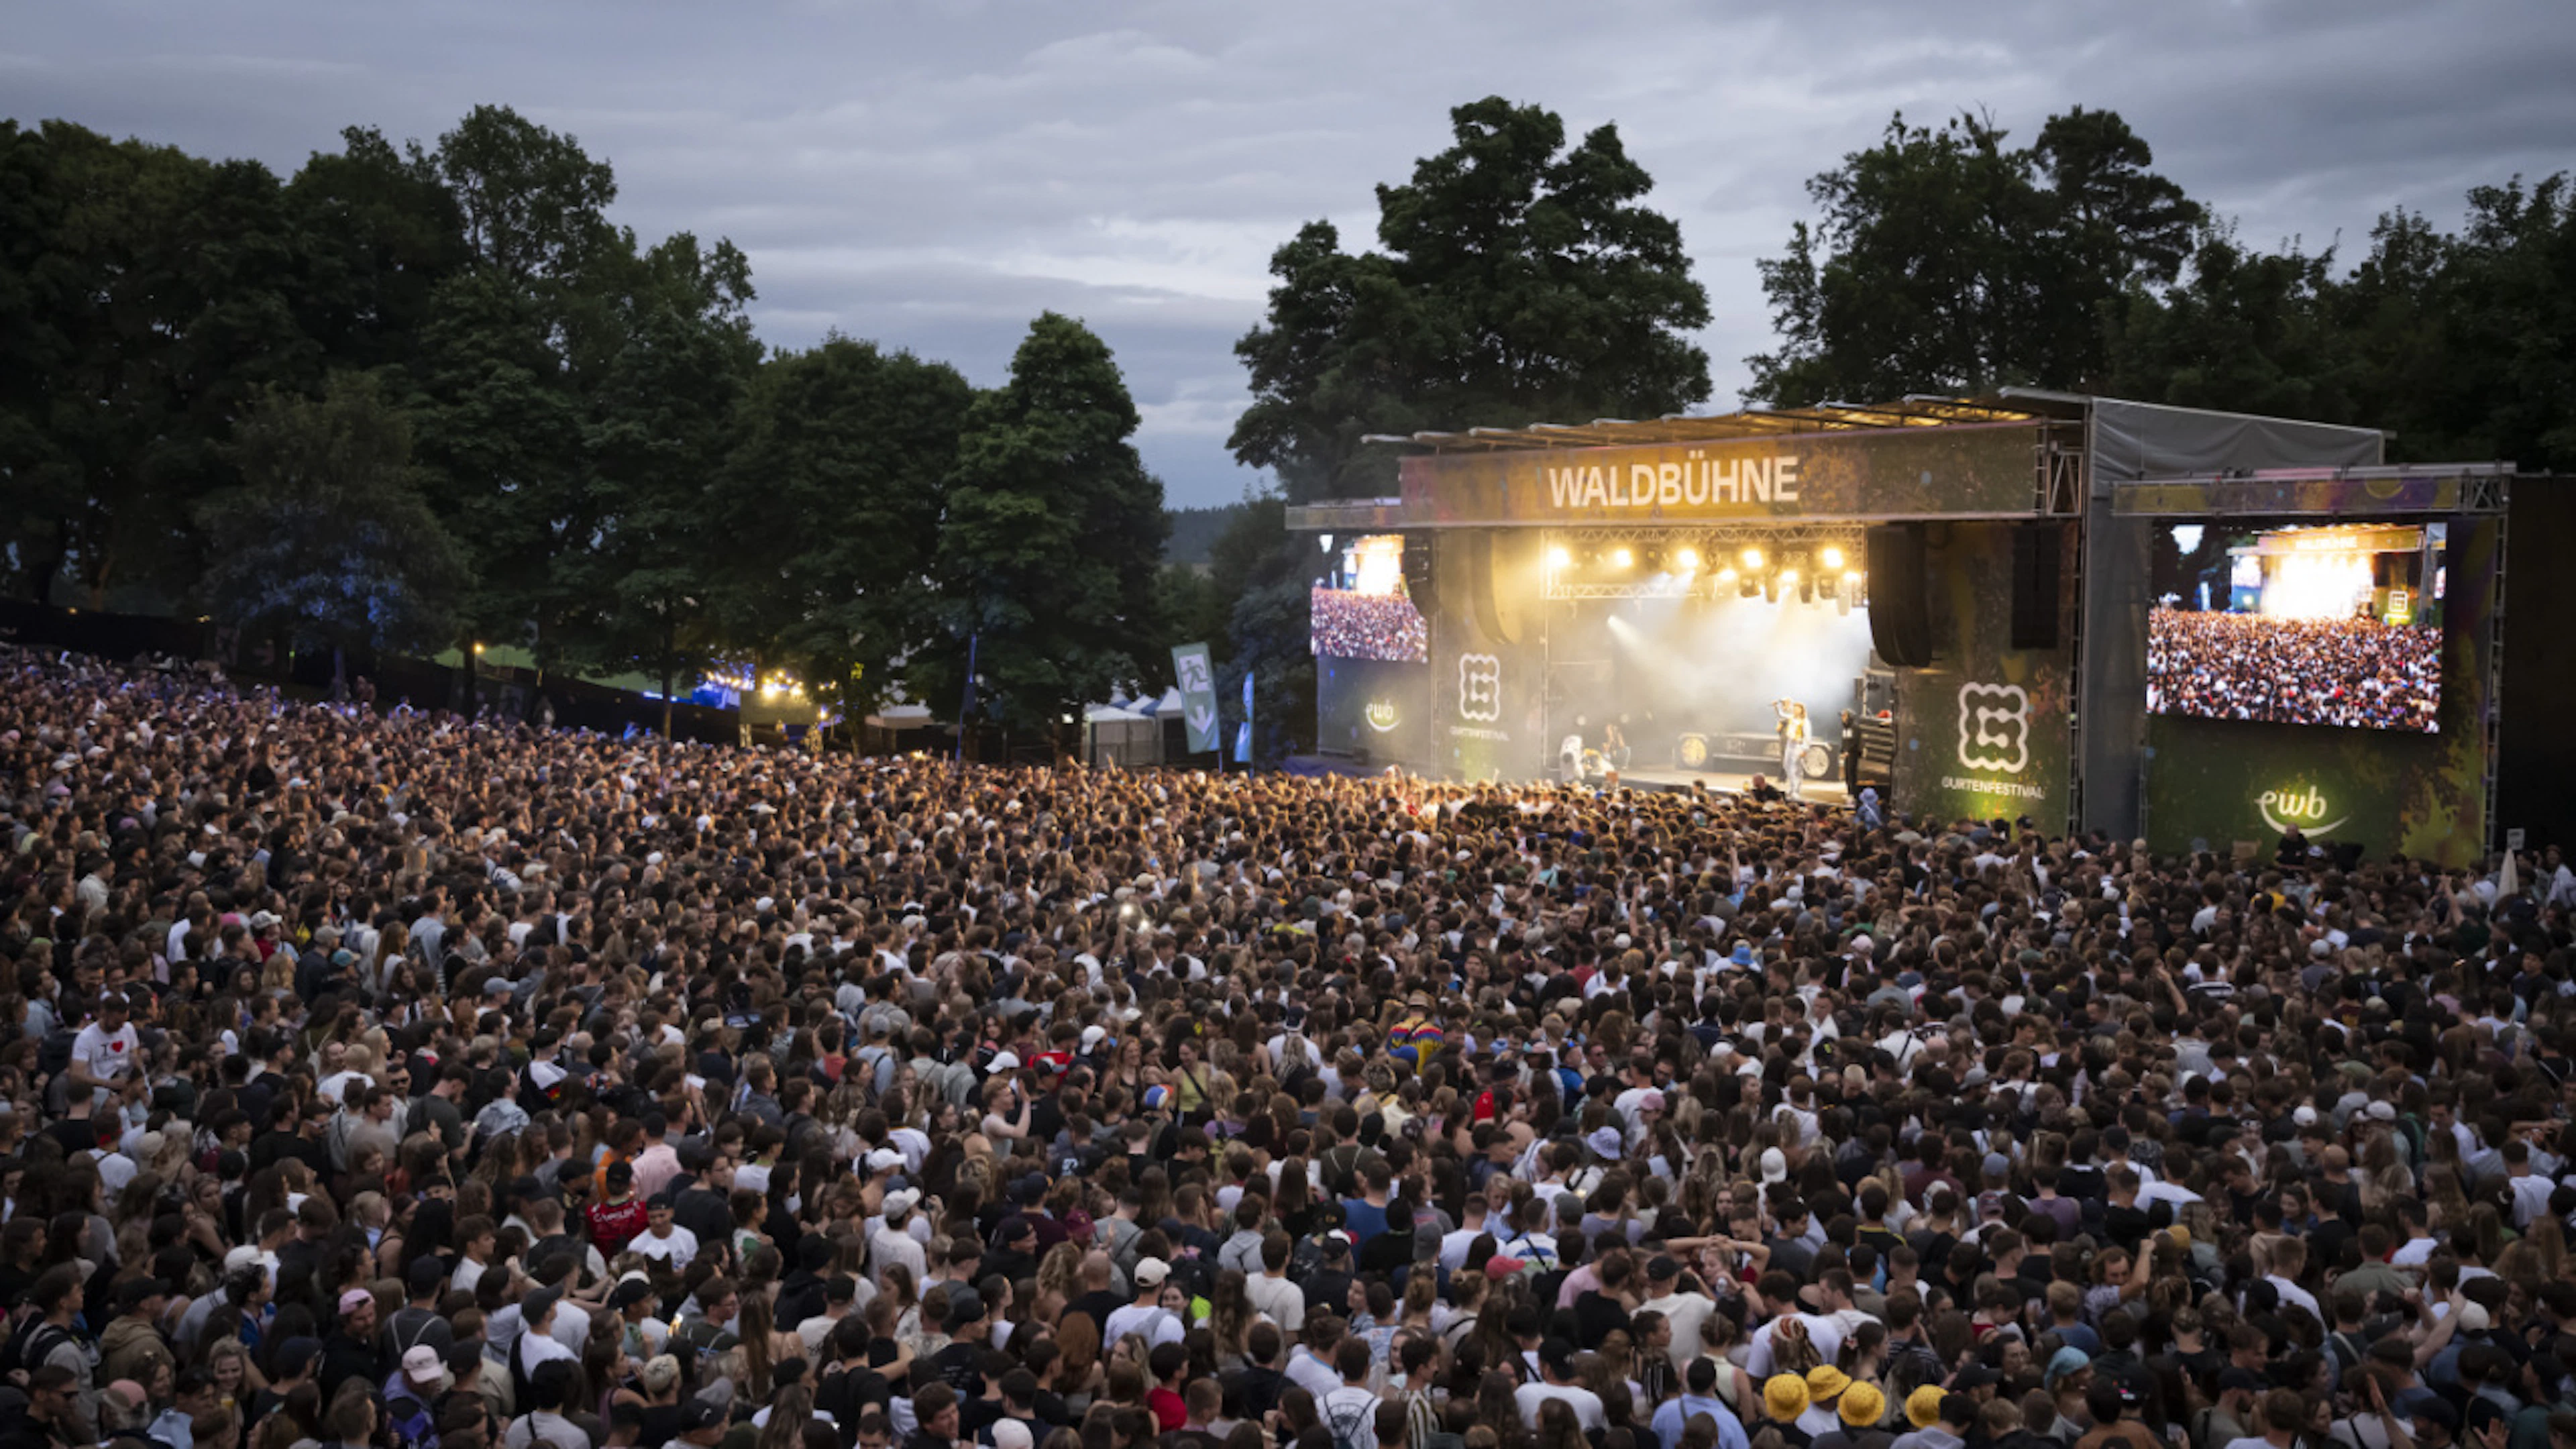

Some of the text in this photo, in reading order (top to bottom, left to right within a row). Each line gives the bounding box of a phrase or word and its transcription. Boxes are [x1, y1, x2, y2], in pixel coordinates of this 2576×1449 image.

[1548, 450, 1799, 508] WALDBÜHNE
[1941, 775, 2045, 800] GURTENFESTIVAL
[2254, 785, 2348, 837] ewb
